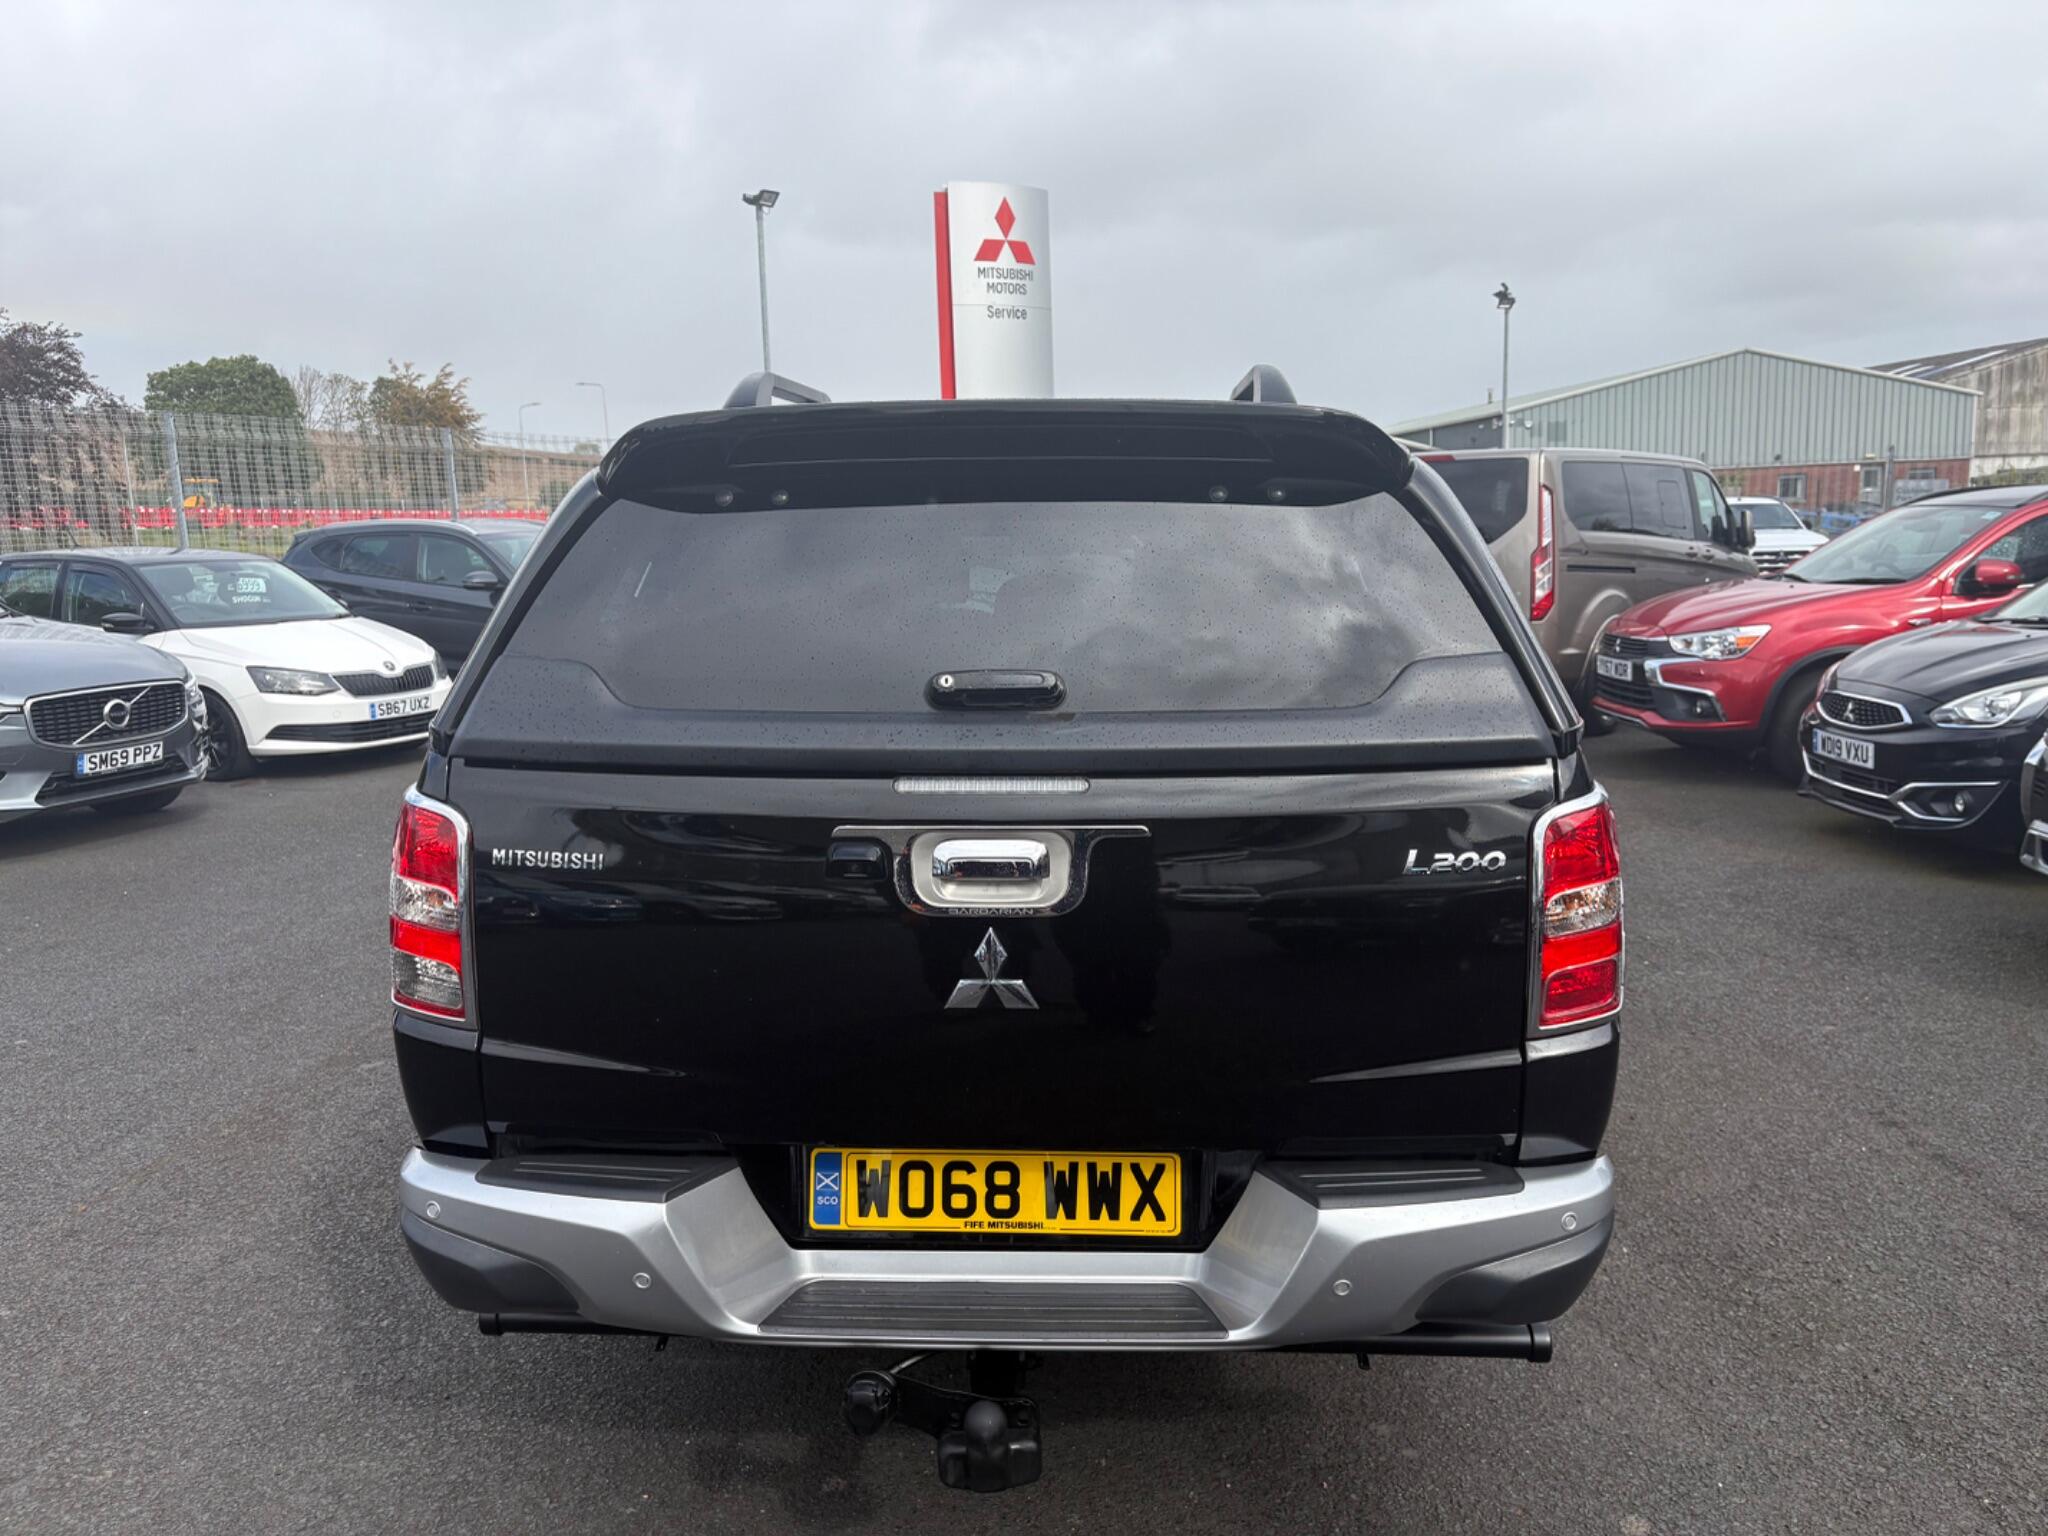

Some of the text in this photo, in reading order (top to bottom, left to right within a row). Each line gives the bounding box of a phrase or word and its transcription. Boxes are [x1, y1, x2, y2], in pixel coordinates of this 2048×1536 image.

[977, 266, 1034, 282] MITSUBISHI
[986, 281, 1028, 296] MOTORS
[986, 304, 1028, 320] Service
[377, 696, 431, 717] SB67 UXZ
[88, 743, 162, 771] SM69 PPZ
[1845, 739, 1870, 764] VXU
[491, 848, 604, 871] MITSUBISHI
[1402, 849, 1507, 875] L200
[816, 1195, 839, 1206] SCO
[856, 1159, 1167, 1222] WO68 WWX
[963, 1220, 1044, 1231] FIFE MITSUBISHI
